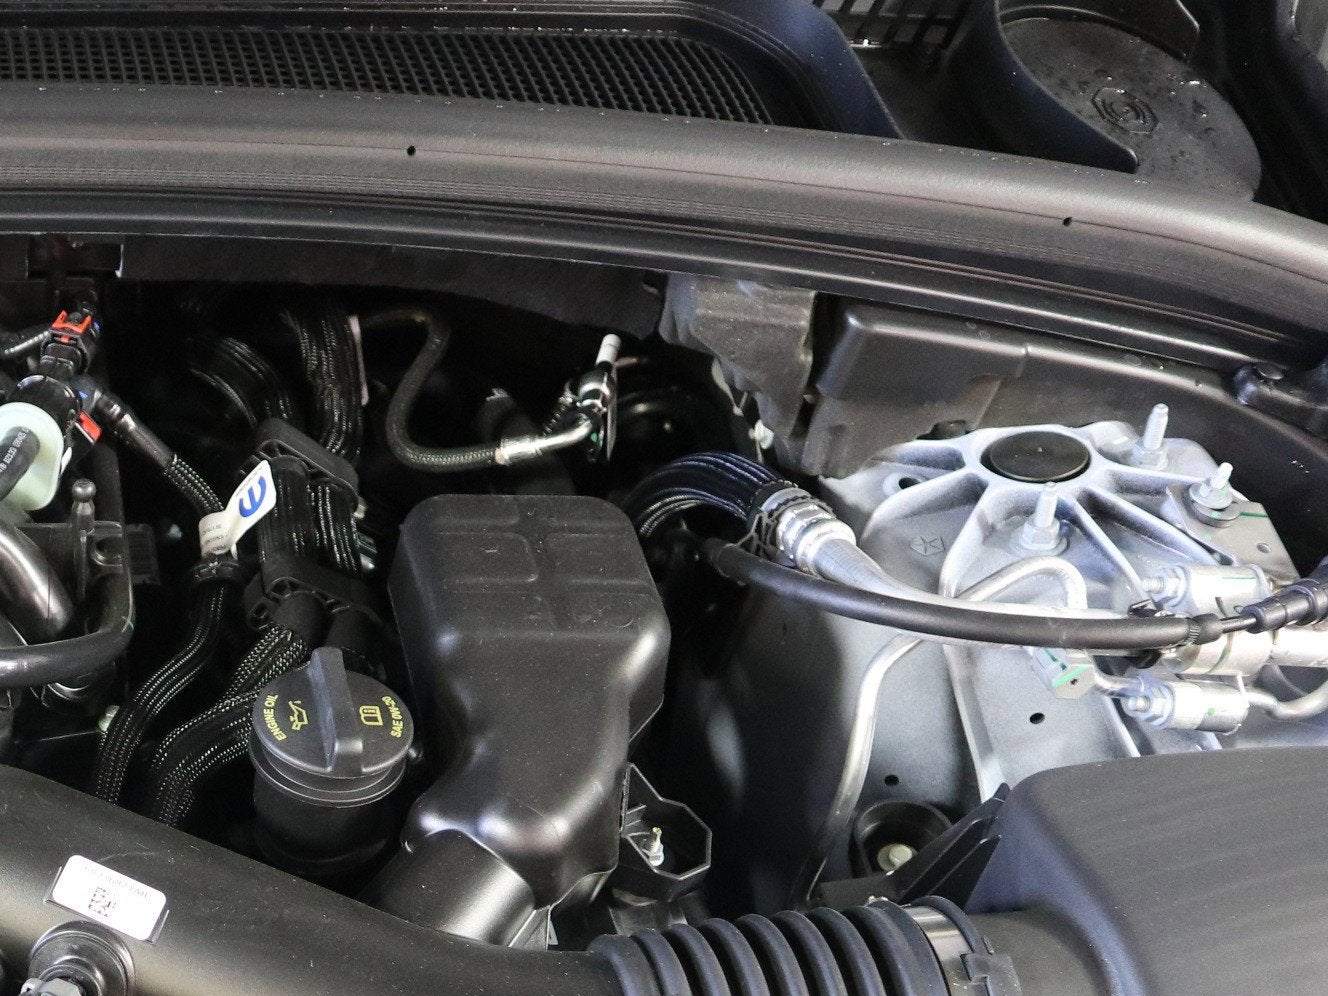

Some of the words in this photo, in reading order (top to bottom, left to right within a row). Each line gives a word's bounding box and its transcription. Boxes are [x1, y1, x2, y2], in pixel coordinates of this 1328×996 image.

[264, 694, 279, 707] OIL
[382, 696, 403, 720] 0W-20
[263, 708, 287, 741] ENGINE
[390, 719, 404, 738] SAE
